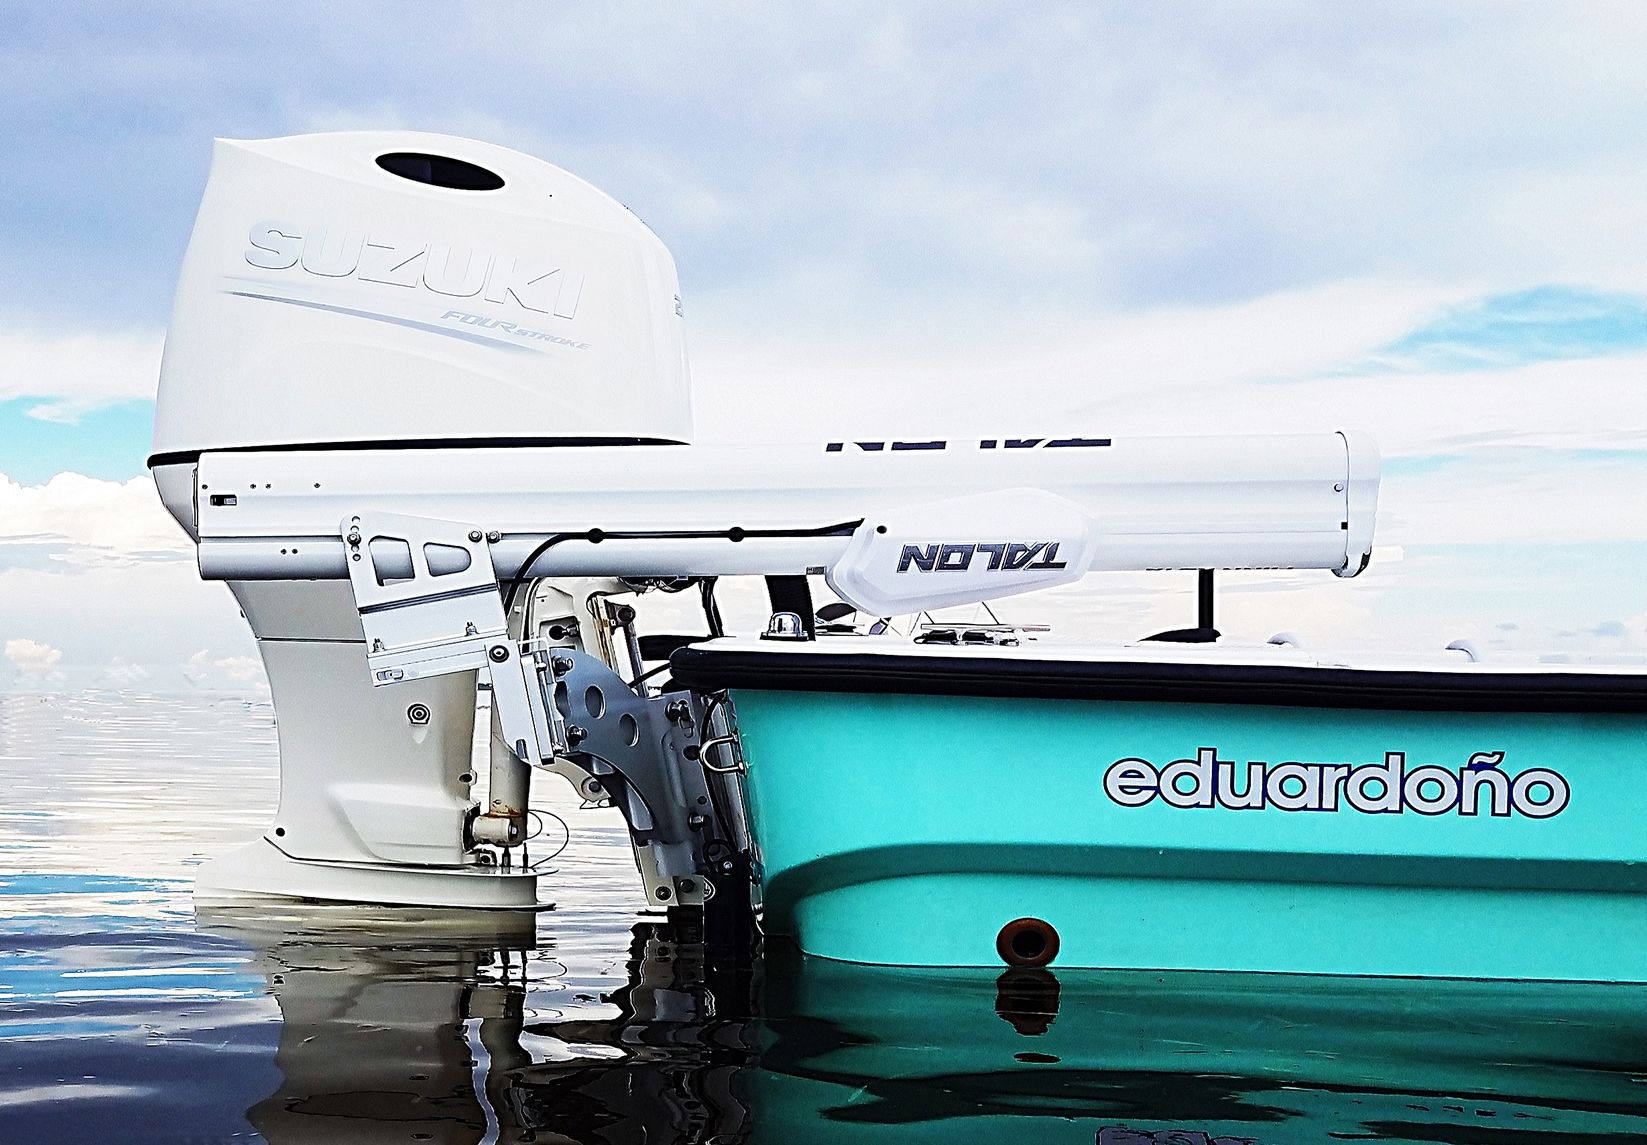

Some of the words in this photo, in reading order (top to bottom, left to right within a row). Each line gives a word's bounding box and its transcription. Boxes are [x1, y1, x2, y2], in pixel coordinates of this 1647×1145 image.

[244, 218, 586, 320] SUZUKI
[440, 309, 518, 335] FOUR
[514, 328, 593, 352] STROKE
[897, 542, 1067, 573] TALON
[1103, 747, 1571, 819] eduardoño
